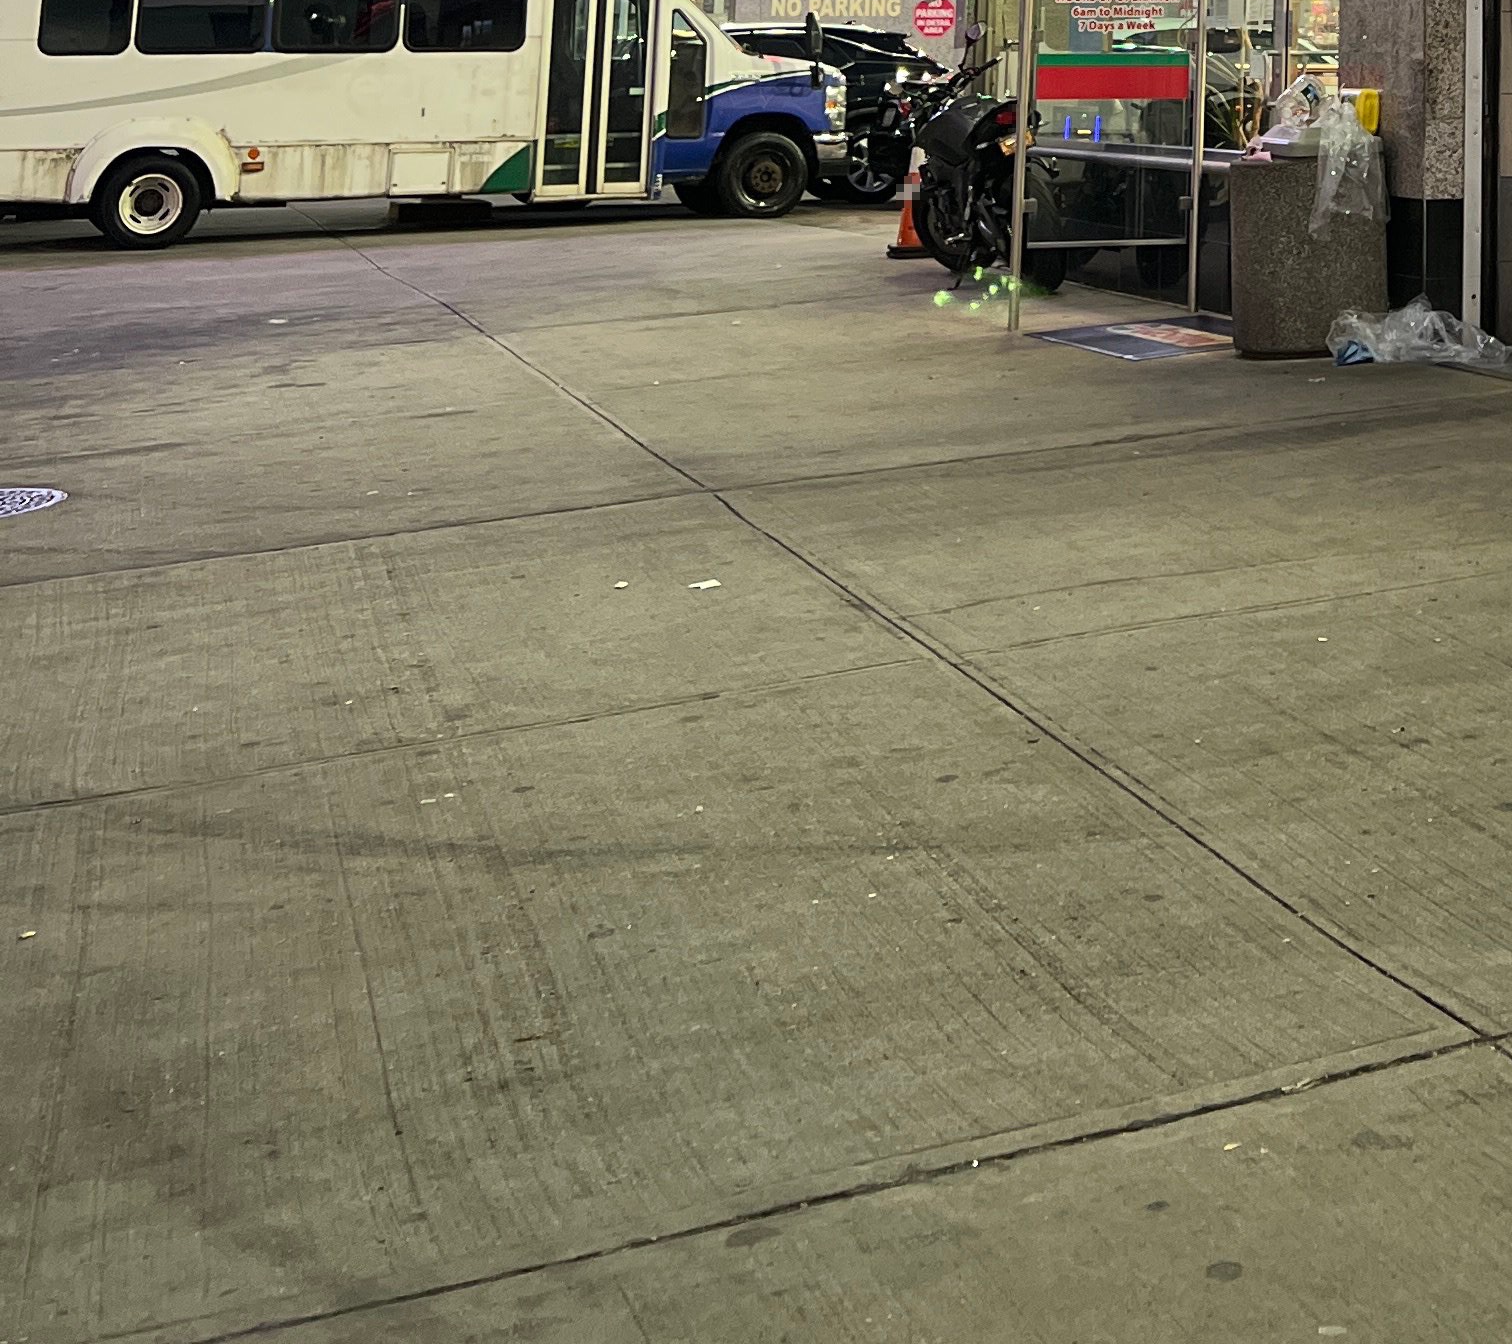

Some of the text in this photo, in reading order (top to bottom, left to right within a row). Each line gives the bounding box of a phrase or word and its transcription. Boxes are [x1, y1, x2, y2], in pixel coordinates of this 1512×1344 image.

[915, 9, 954, 18] PARKING
[1072, 7, 1163, 19] 6am to Midnight
[1079, 20, 1156, 32] 7 Days a Week
